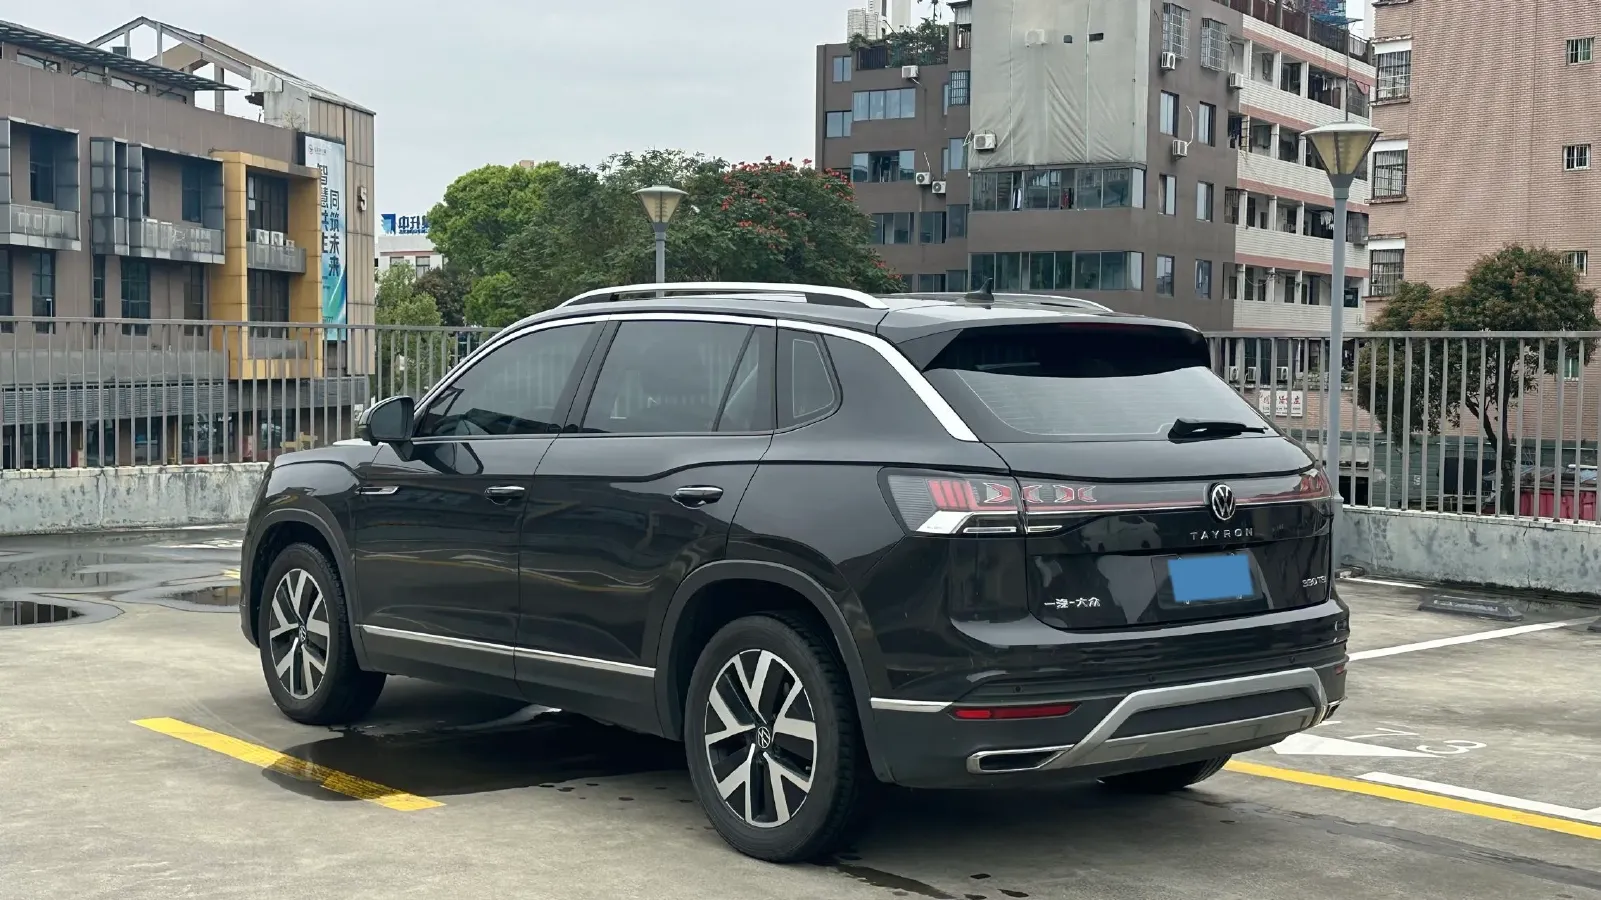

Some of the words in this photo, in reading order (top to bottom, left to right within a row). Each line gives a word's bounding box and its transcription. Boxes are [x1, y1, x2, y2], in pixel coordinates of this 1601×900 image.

[358, 186, 367, 212] 5
[329, 190, 339, 276] 同筑未来
[1190, 528, 1253, 540] TAYRON
[1044, 597, 1100, 609] 一汽-大众
